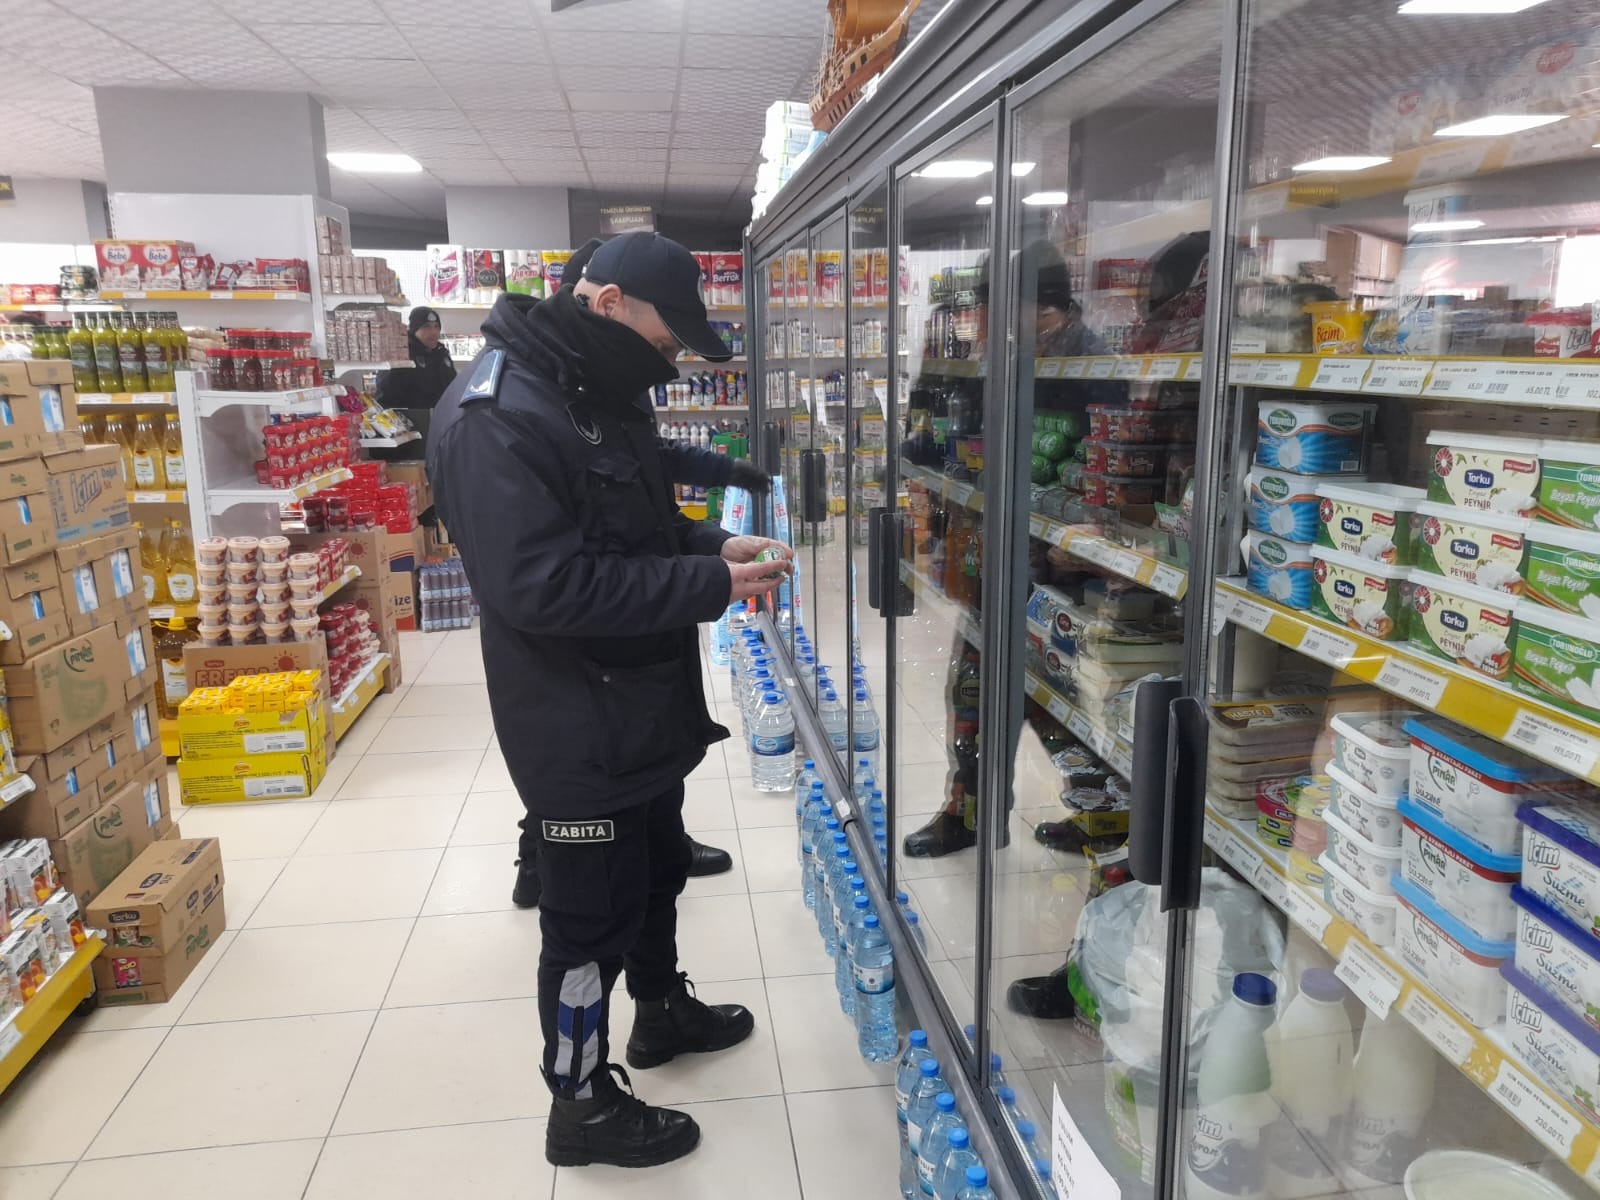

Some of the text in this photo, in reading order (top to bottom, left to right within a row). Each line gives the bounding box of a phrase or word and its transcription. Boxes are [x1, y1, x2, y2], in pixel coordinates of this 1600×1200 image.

[1467, 472, 1491, 486] Torku
[1464, 498, 1491, 510] PEYNİR
[1343, 520, 1361, 532] Torku
[1454, 542, 1476, 556] Torku
[1450, 567, 1476, 581] PEYNİR
[1336, 582, 1354, 595] Torku
[394, 596, 411, 606] ize
[1443, 613, 1465, 628] Torku
[1440, 637, 1466, 653] PEYNİR
[1552, 638, 1593, 658] TORUNOĞLU
[550, 826, 606, 838] ZABITA
[1528, 832, 1560, 866] İçim
[1543, 870, 1586, 908] Süzme
[111, 912, 138, 922] Torku
[1521, 912, 1553, 947] İçim
[1536, 953, 1578, 992] Süzme
[1511, 990, 1542, 1027] İçim
[1526, 1031, 1567, 1072] Süzme
